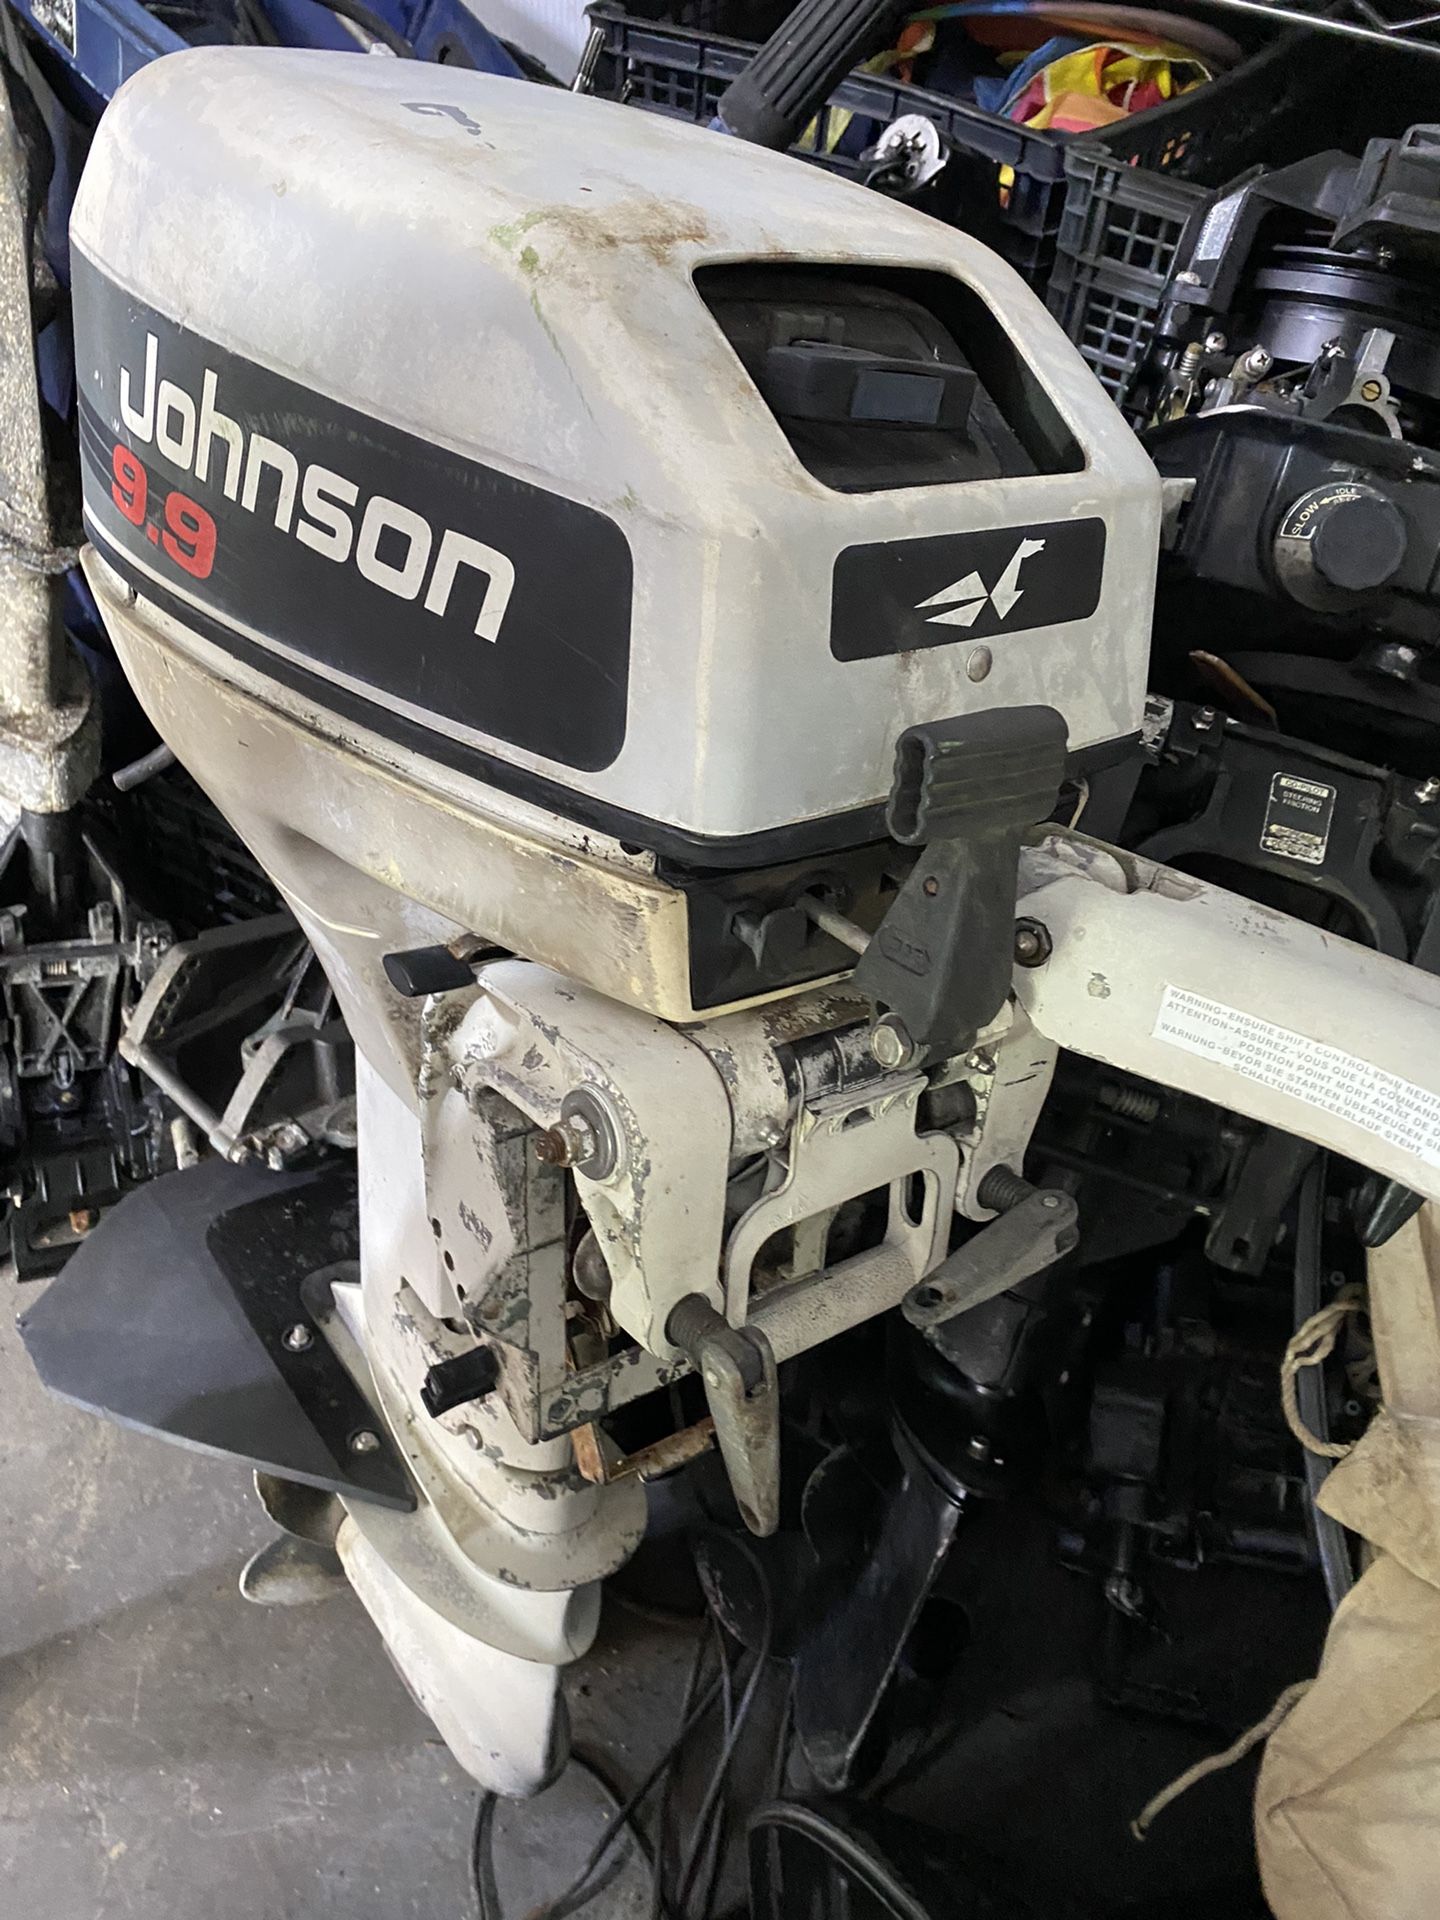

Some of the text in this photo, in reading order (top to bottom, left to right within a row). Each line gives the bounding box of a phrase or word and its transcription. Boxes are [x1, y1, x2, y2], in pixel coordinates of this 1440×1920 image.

[120, 331, 515, 644] Johnson
[1336, 487, 1356, 495] IDLE
[111, 444, 218, 580] 9.9
[1291, 501, 1320, 534] SLOW
[1278, 1031, 1312, 1050] SHIFT
[1314, 1046, 1372, 1077] CONTROL
[1233, 1063, 1303, 1098] SCHALTUNG
[1239, 1040, 1295, 1069] POSITION
[1296, 1064, 1334, 1084] POINT
[1335, 1080, 1371, 1101] MORT
[1412, 1117, 1430, 1131] DE
[1264, 1063, 1284, 1078] SIE
[1287, 1072, 1341, 1102] STARTEN
[1331, 1065, 1360, 1081] QUE
[1360, 1078, 1376, 1091] LA
[1379, 1087, 1440, 1124] COMMAND
